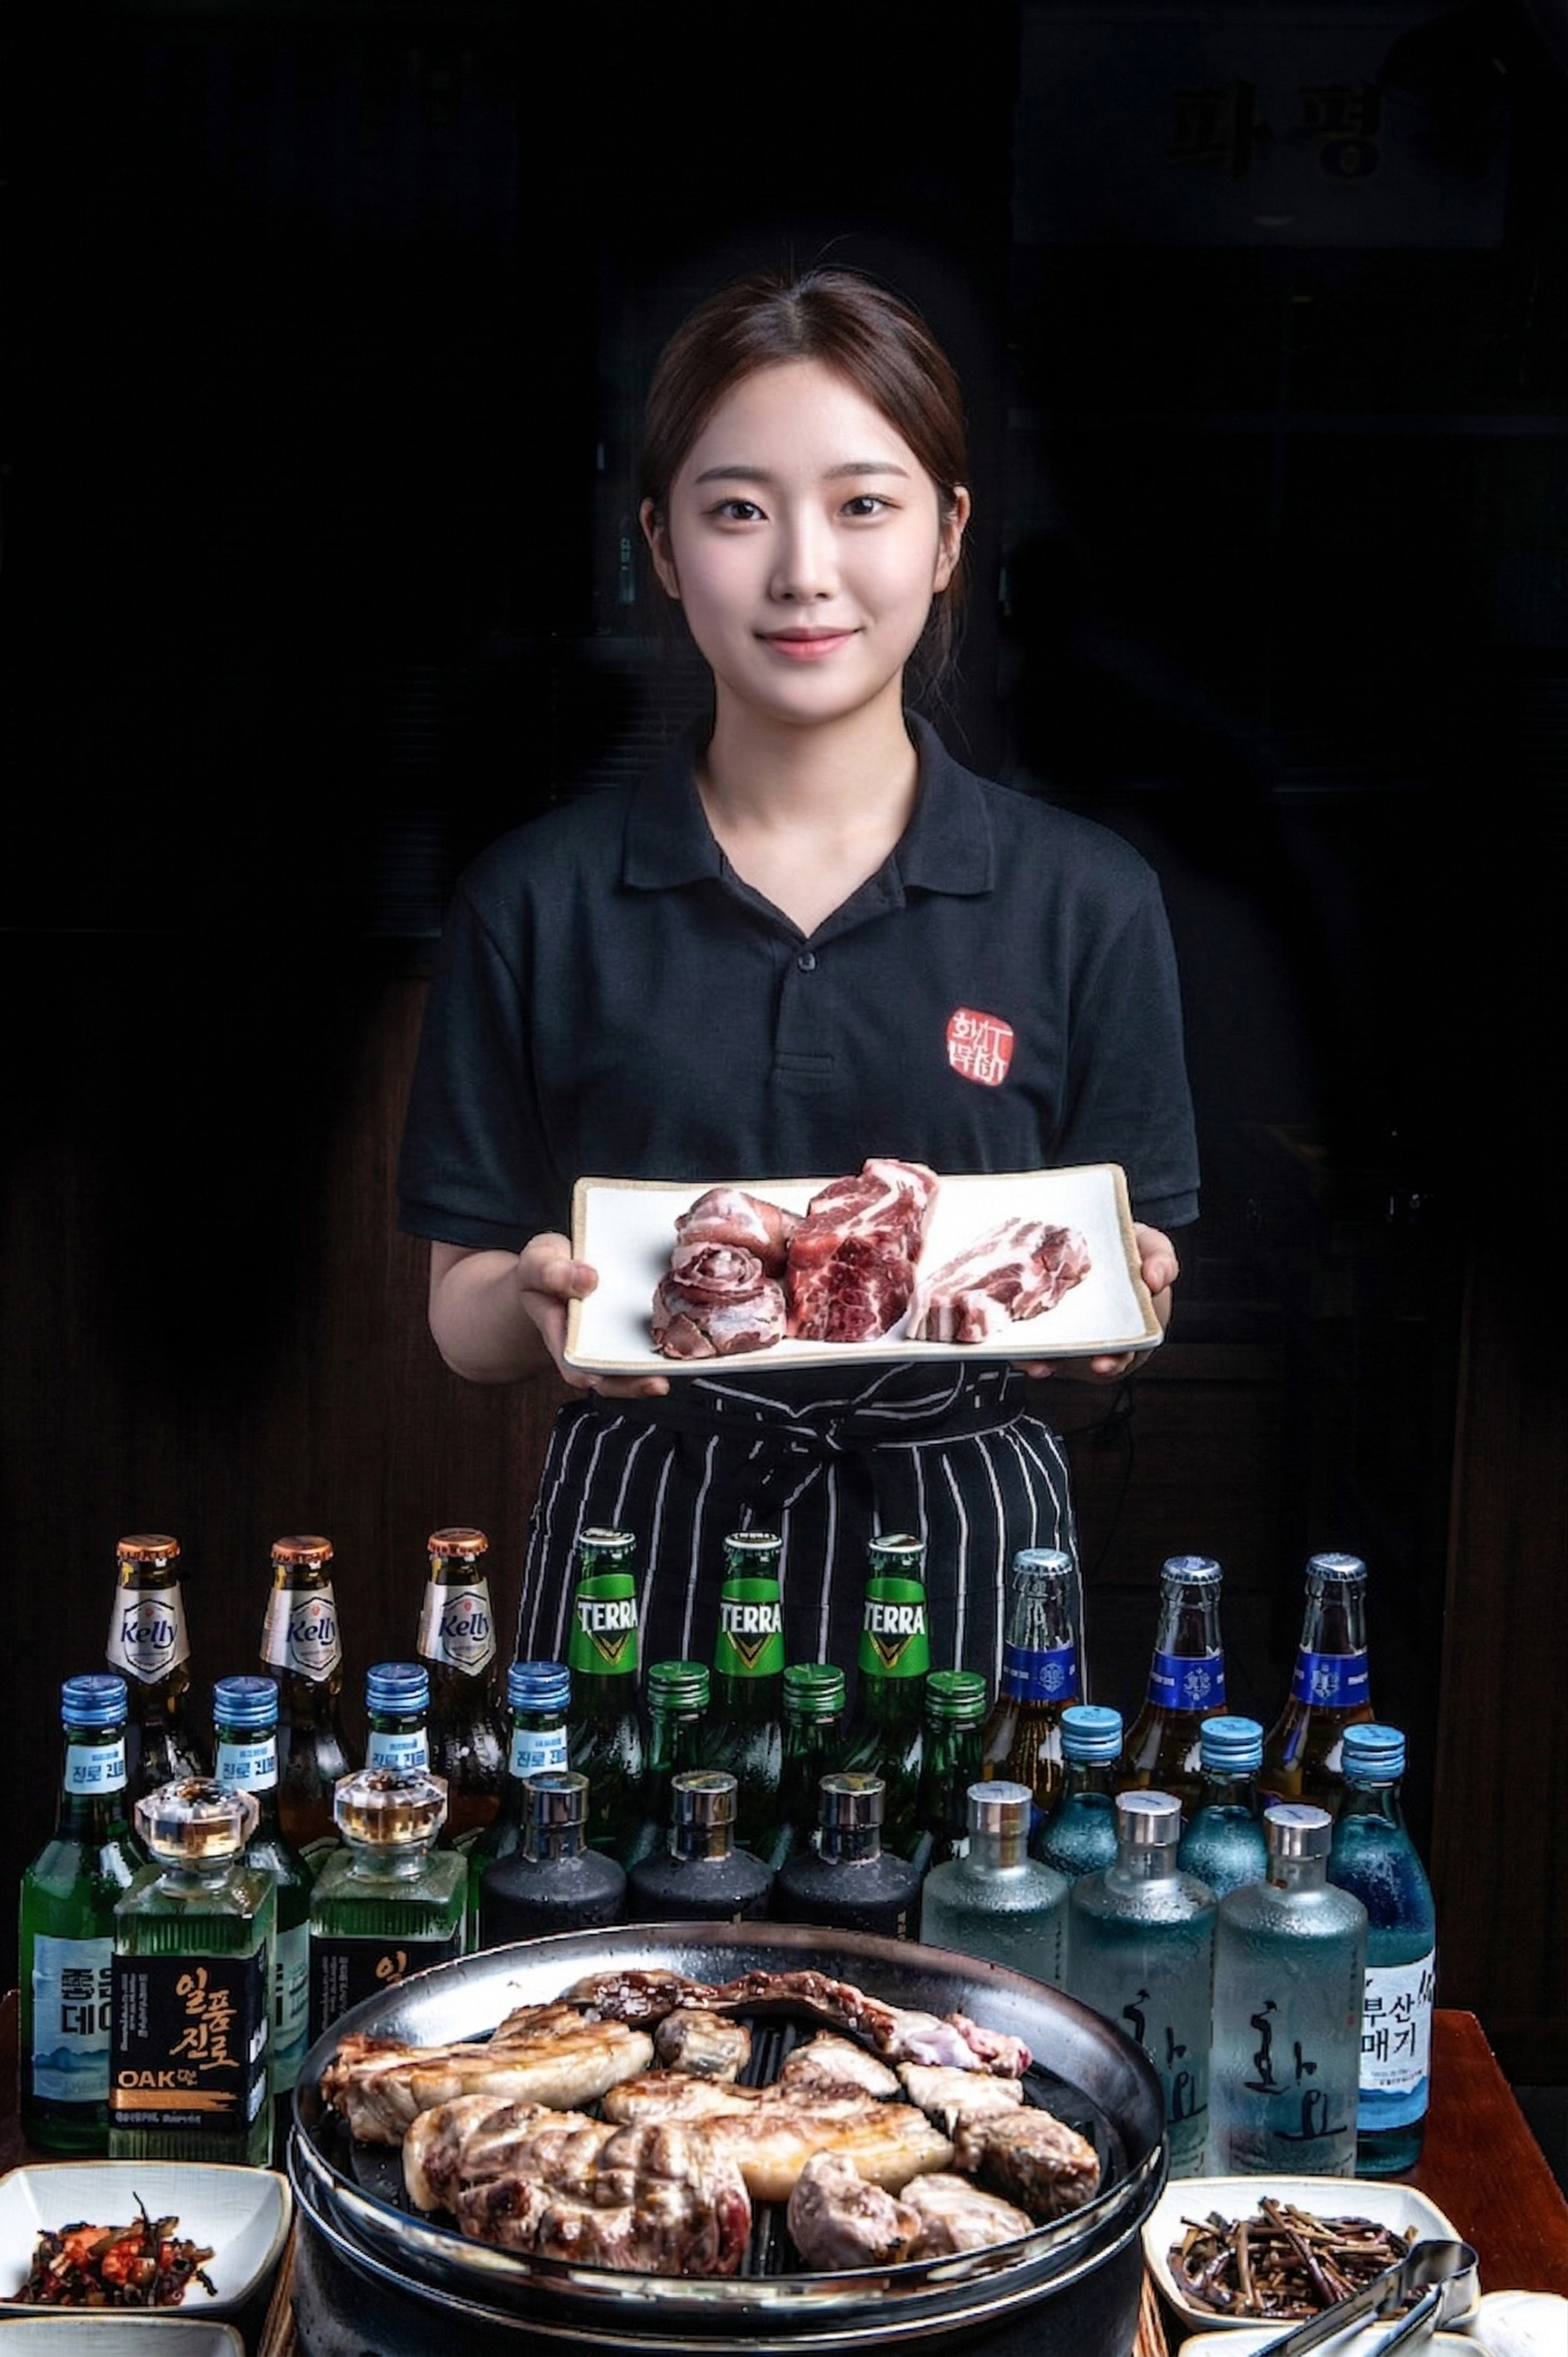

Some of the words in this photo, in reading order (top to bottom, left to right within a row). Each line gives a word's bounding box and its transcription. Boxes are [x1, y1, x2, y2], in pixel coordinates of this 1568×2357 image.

[438, 1613, 489, 1642] Kelly
[578, 1598, 639, 1632] TERRA
[721, 1603, 782, 1633] TERRA
[864, 1601, 926, 1634] TERRA
[121, 1620, 177, 1648] Kelly
[286, 1618, 336, 1647] Kelly
[1364, 1992, 1416, 2028] 부산
[118, 2070, 176, 2088] OAK
